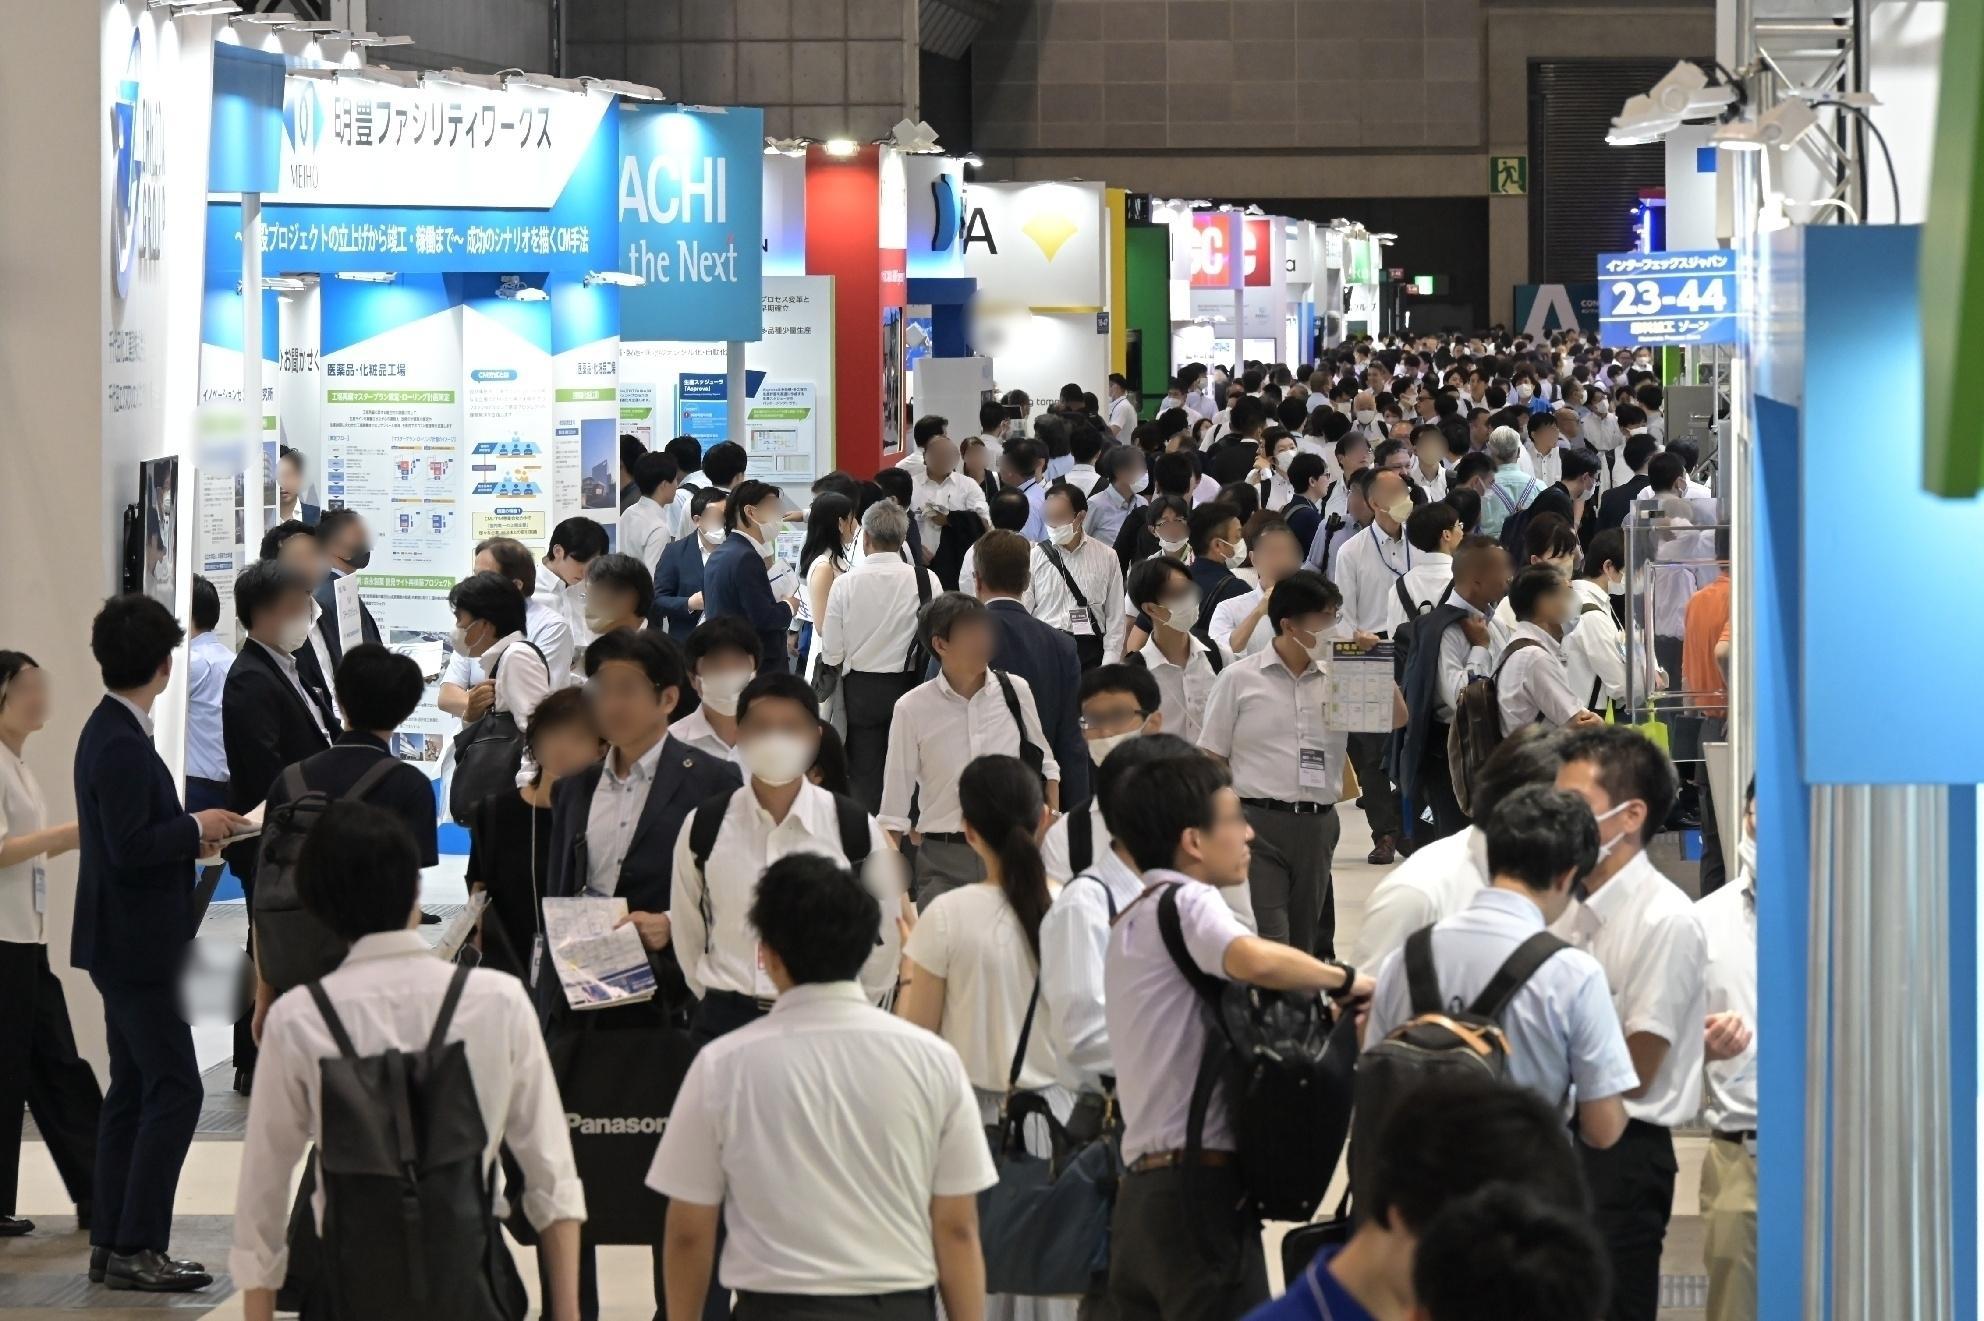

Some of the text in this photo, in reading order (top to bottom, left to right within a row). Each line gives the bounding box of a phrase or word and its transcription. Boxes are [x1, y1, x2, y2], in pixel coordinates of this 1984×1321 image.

[334, 97, 552, 150] 明豊ファシリティワークス
[290, 163, 319, 188] MEIHO
[619, 155, 726, 224] ACHI
[629, 238, 738, 283] the Next
[1606, 255, 1728, 272] インターフェックスジャパン
[1611, 278, 1727, 315] 23-44
[327, 363, 406, 377] 医薬品・化粧品工場
